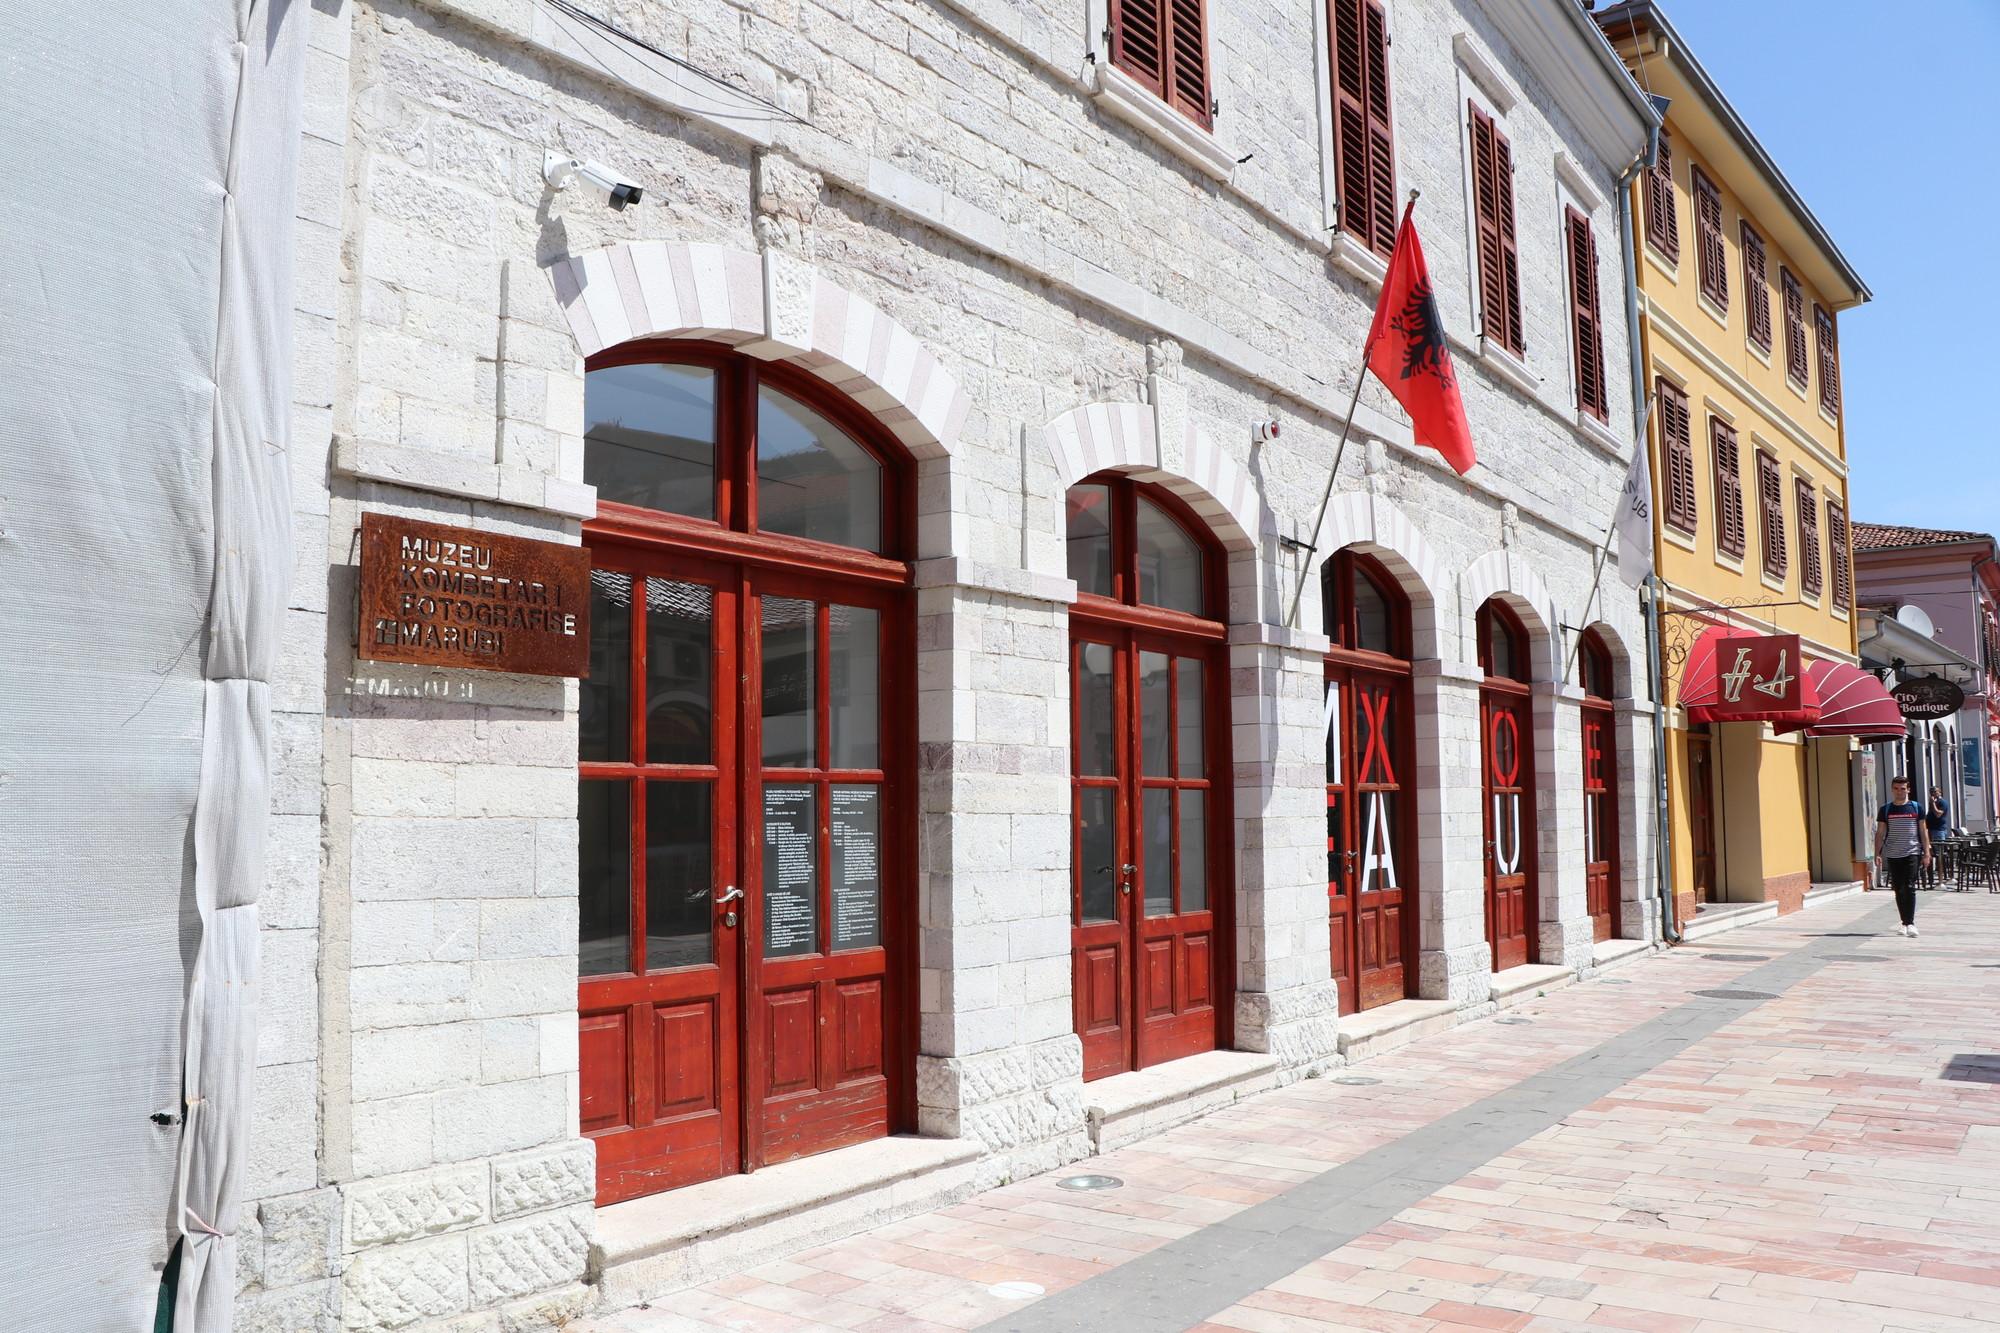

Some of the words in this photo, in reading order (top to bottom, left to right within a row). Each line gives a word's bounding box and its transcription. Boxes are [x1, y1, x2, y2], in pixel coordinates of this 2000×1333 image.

[402, 535, 492, 570] MUZEU
[401, 564, 548, 605] KOMBETAR
[555, 584, 561, 607] I
[400, 593, 577, 636] FOTOGRAFISE
[401, 621, 502, 655] MARUBI
[1894, 692, 1918, 704] City
[1900, 703, 1950, 714] Boutique
